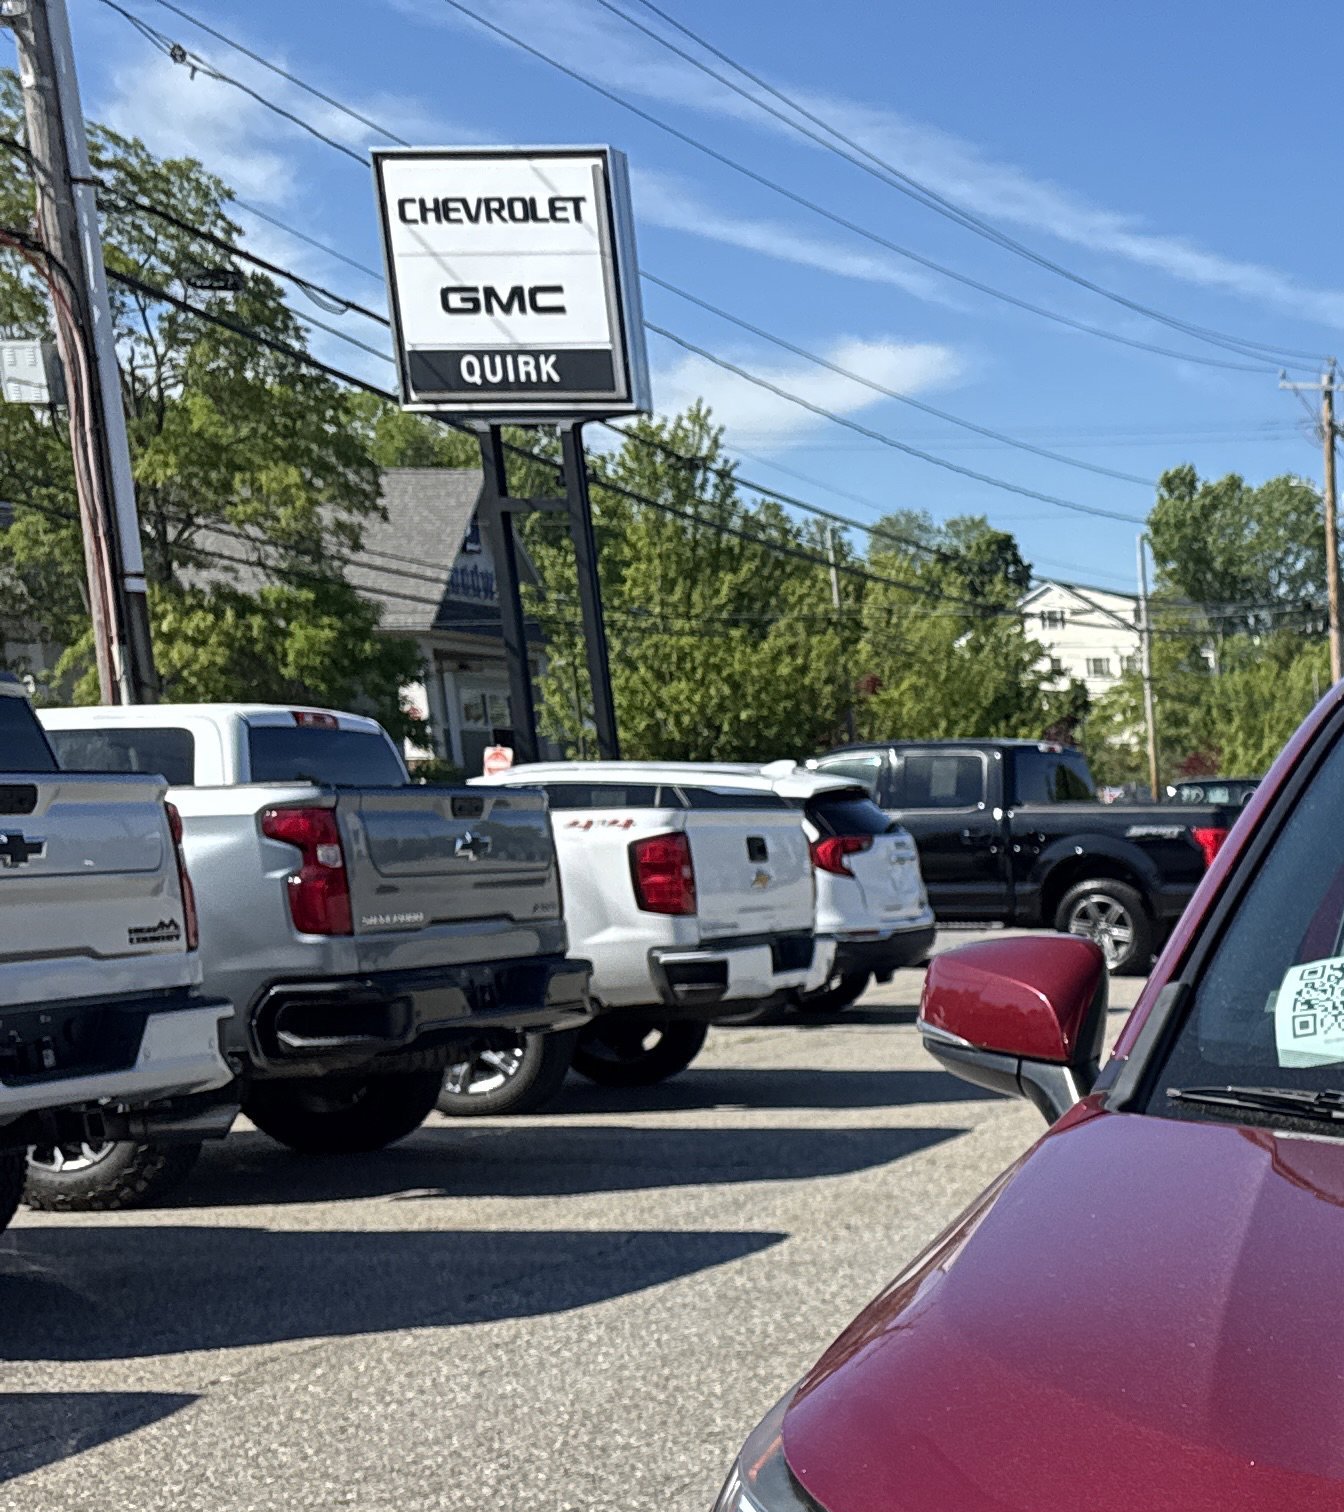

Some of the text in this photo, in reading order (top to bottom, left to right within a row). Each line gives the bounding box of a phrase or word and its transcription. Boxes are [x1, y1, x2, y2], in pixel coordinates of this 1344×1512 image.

[398, 196, 586, 224] CHEVROLET
[440, 285, 567, 316] GMC
[460, 353, 561, 386] QUIRK
